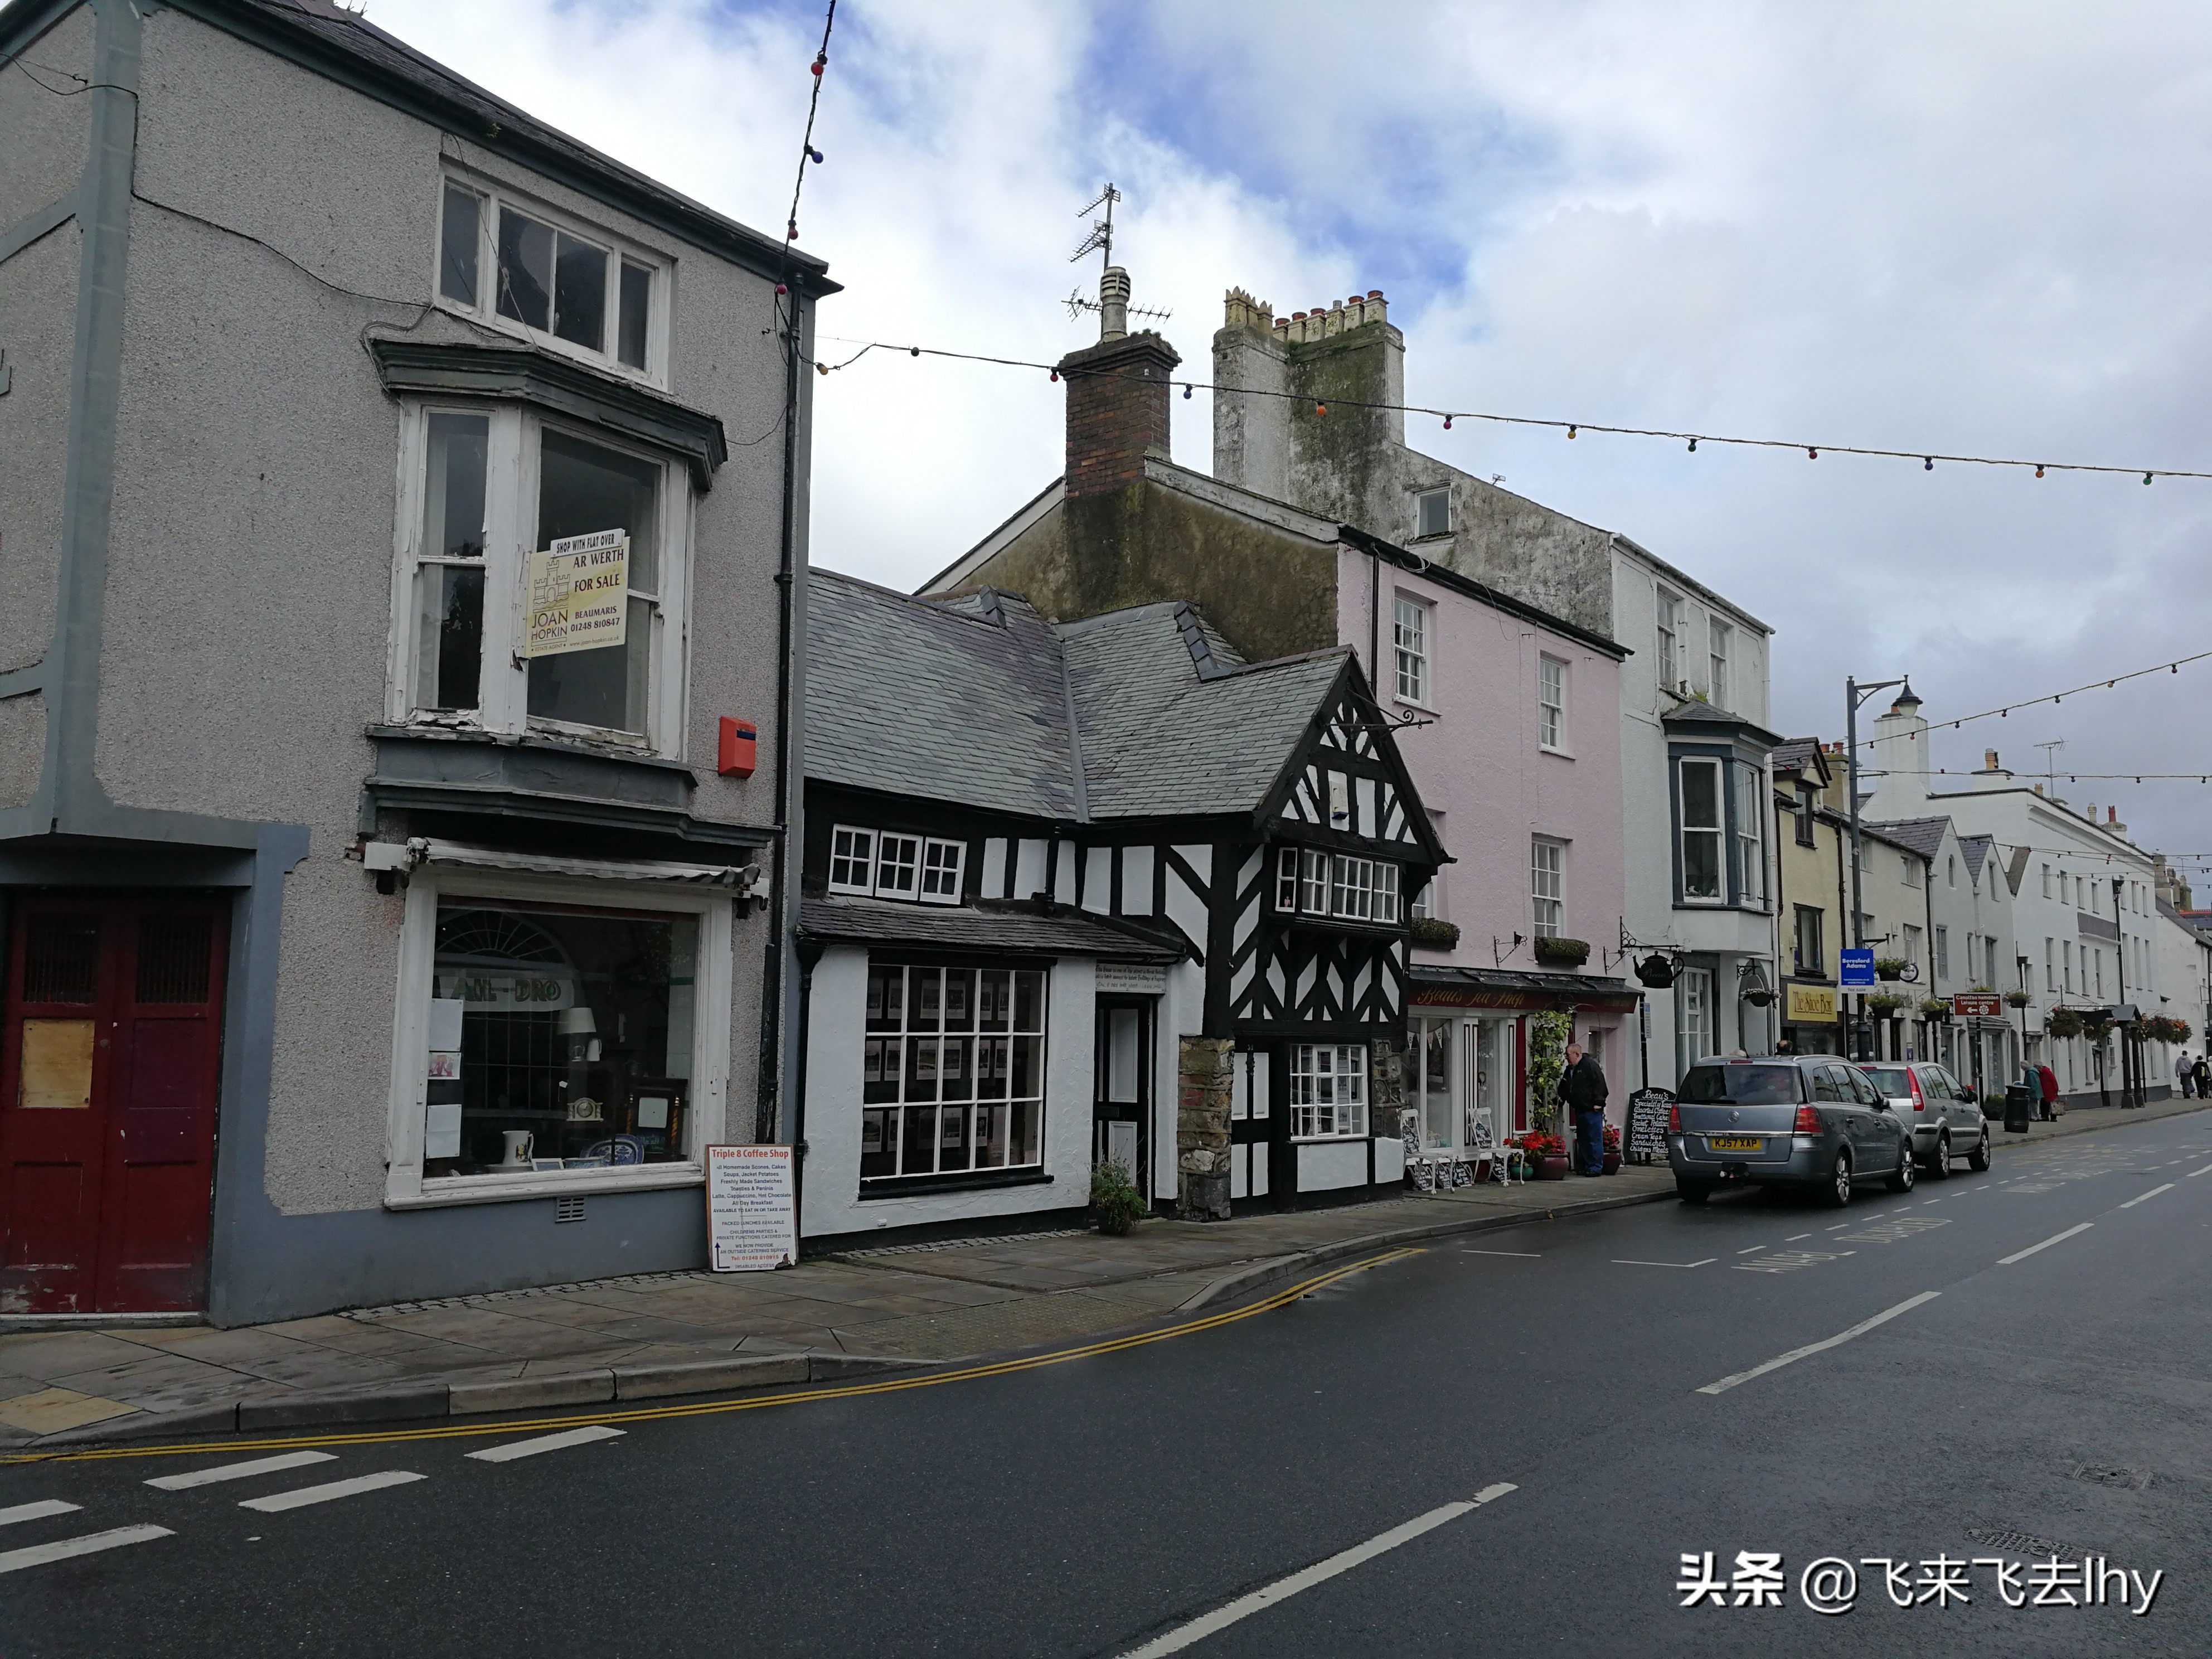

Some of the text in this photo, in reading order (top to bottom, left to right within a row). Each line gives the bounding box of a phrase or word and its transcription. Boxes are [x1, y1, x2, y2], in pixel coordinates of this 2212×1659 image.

[557, 533, 614, 554] SHOP WITH FLAT OVER
[574, 549, 624, 569] AR WERTH
[574, 574, 620, 593] FOR SALE
[532, 609, 568, 628] JOAN
[575, 606, 617, 619] BEAUMARIS
[571, 618, 620, 632] 01248 810847
[531, 625, 567, 641] HOPKIN
[1793, 991, 1803, 1012] The
[1820, 994, 1832, 1014] Box
[1642, 1089, 1668, 1100] Beau's
[1631, 1139, 1666, 1147] Sandwiches
[1715, 1138, 1757, 1147] KJ57 XAP
[712, 1149, 735, 1160] Triple
[770, 1149, 789, 1159] Shop
